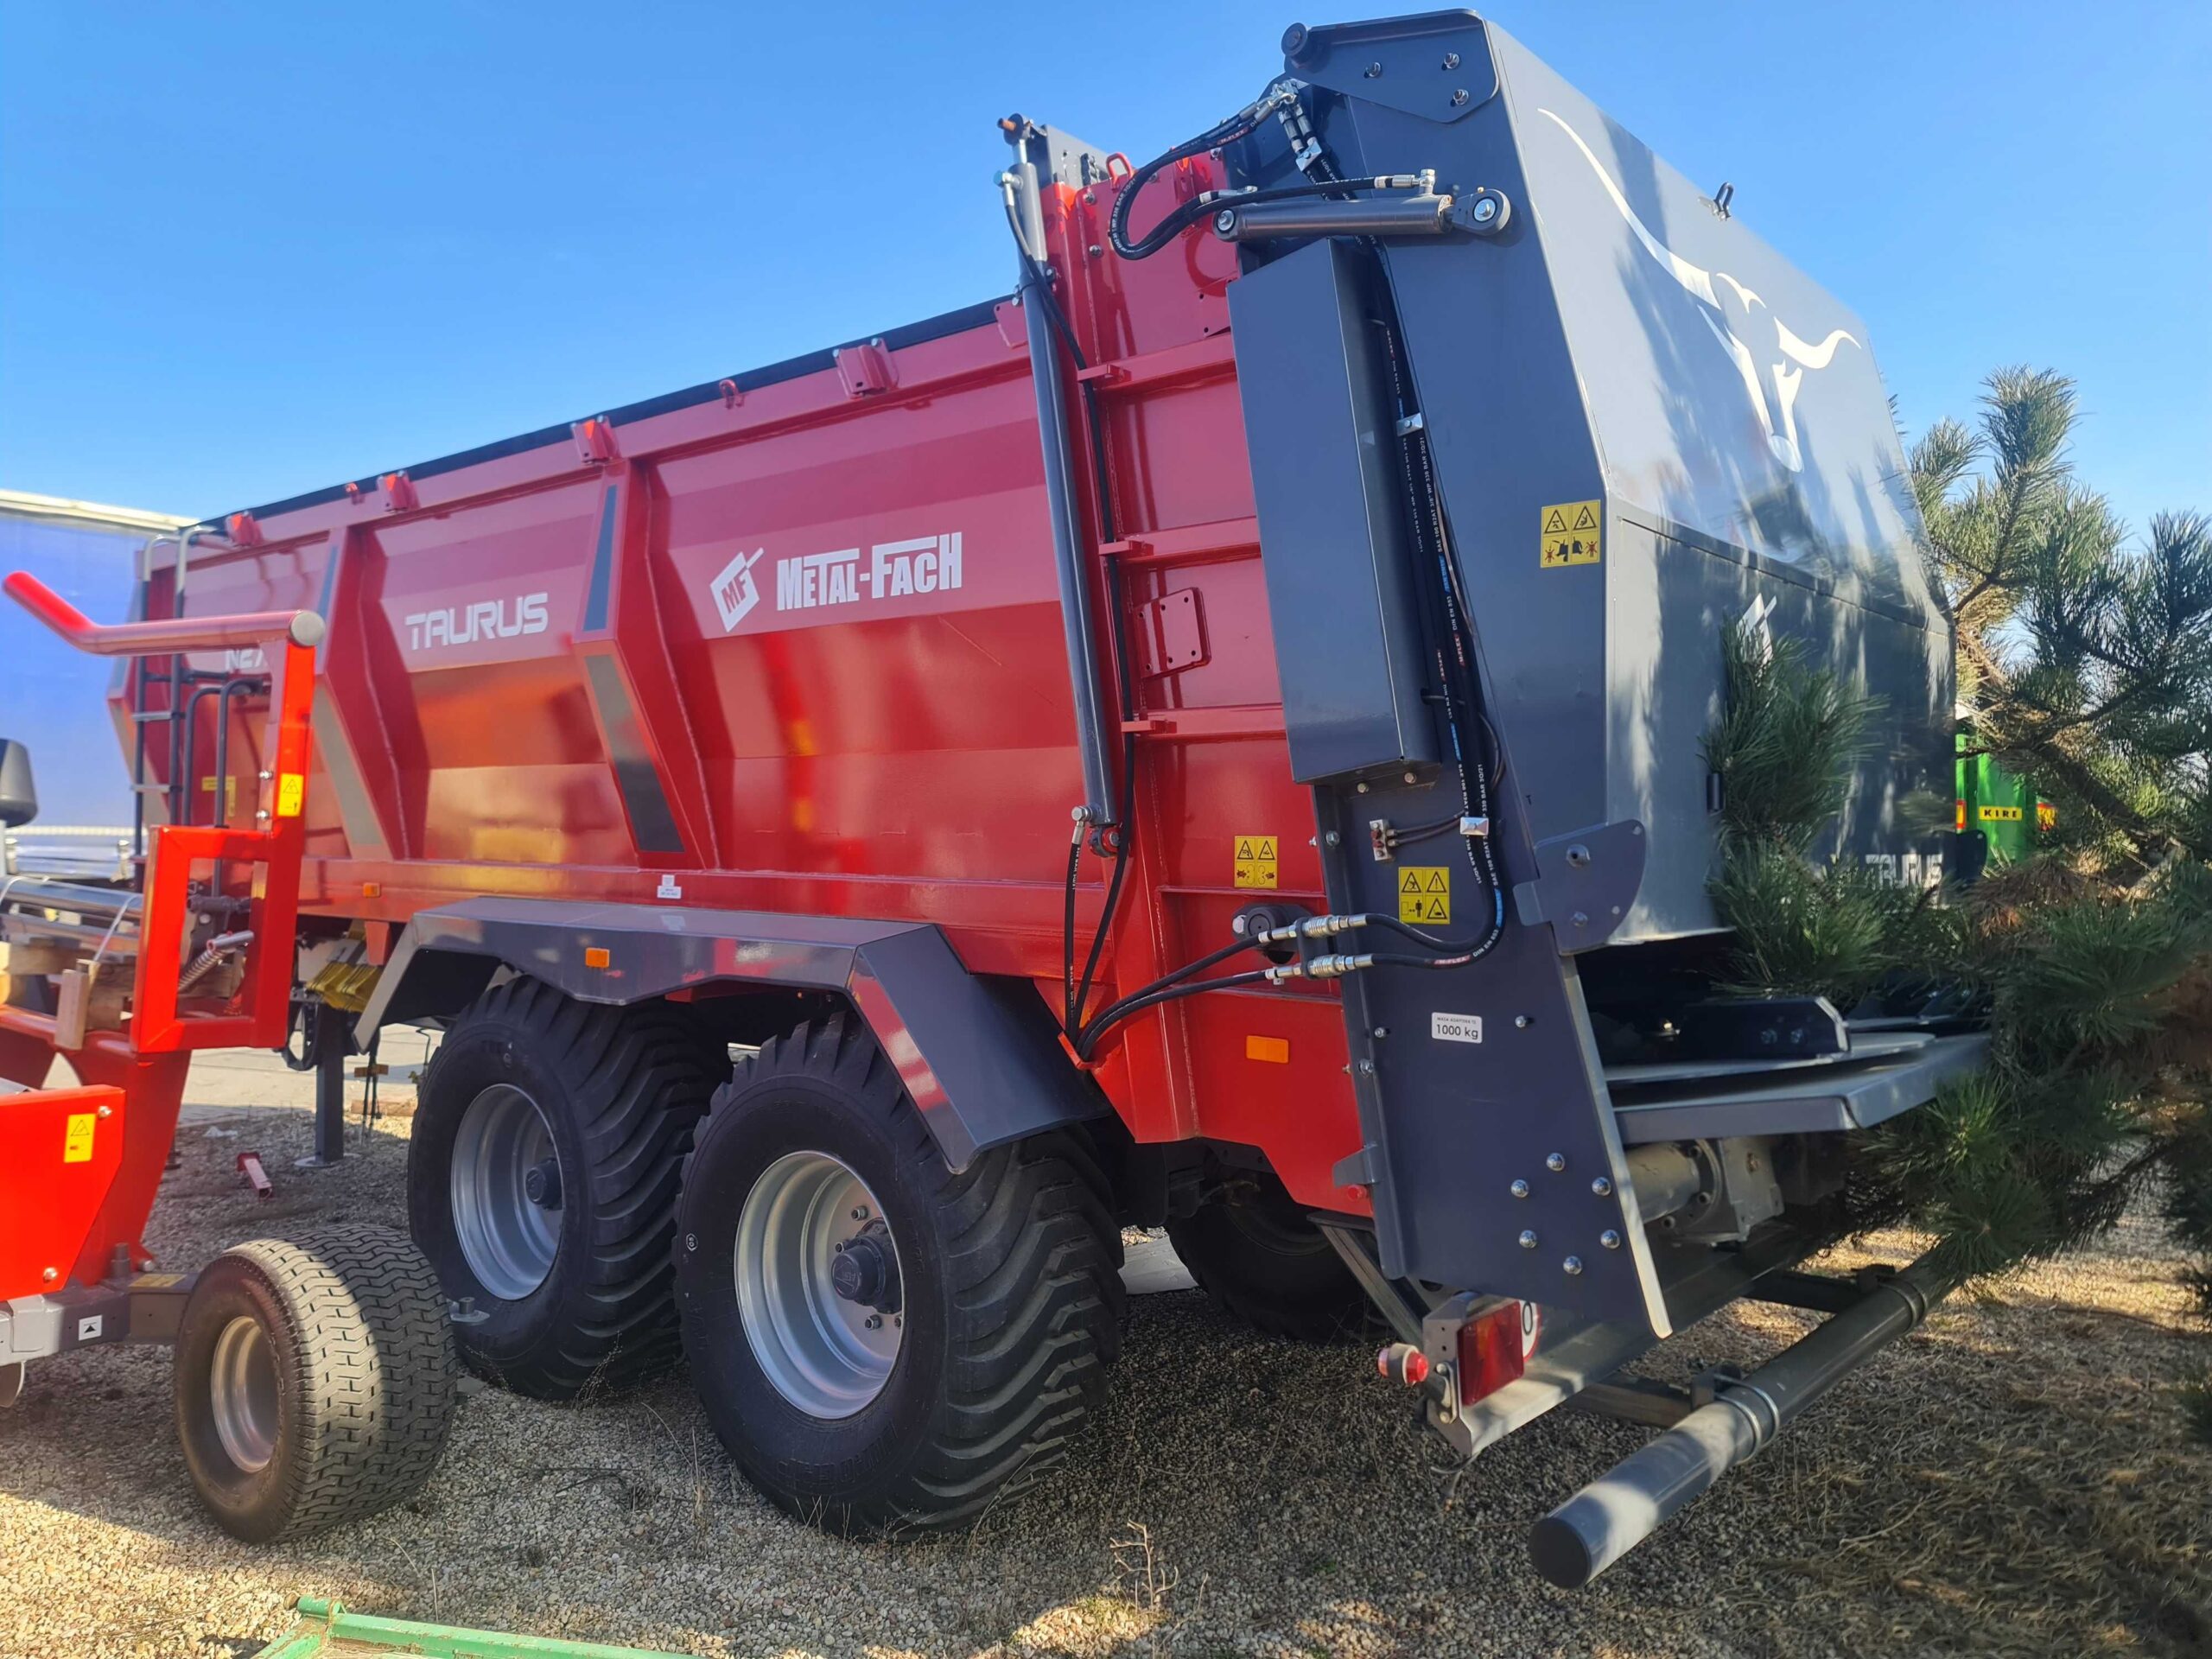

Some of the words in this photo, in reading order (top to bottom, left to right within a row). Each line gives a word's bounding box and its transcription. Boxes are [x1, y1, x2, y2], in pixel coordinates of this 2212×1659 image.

[777, 531, 962, 611] METAL-FACH
[405, 591, 549, 651] TAURUS
[1472, 948, 1485, 957] DIN
[1436, 1024, 1461, 1036] 1000
[1465, 1027, 1478, 1040] kg
